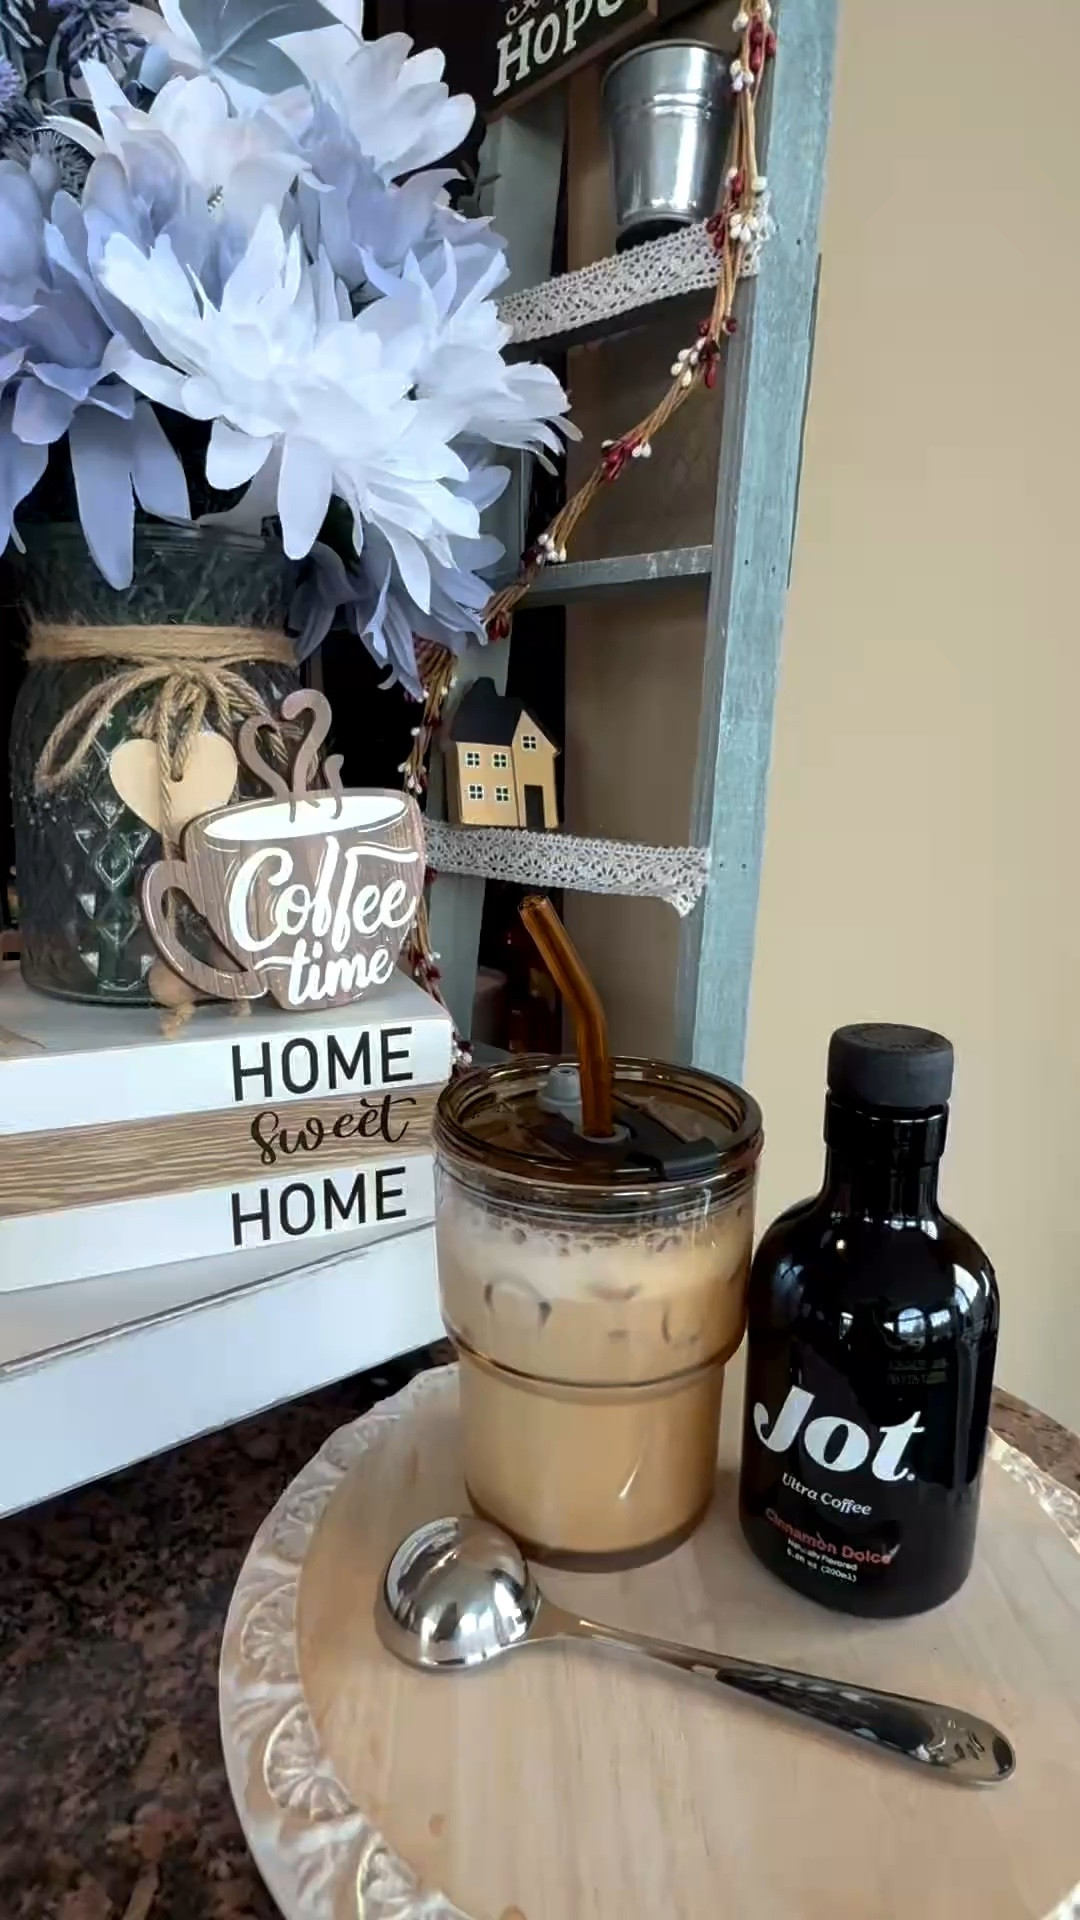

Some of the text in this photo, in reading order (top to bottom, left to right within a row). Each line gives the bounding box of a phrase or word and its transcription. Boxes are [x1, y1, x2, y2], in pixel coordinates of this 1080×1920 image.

[229, 835, 419, 952] Coffee
[254, 938, 394, 1006] time
[231, 1026, 413, 1101] HOME
[231, 1166, 407, 1246] HOME
[782, 1472, 872, 1515] Ultra Coffee
[765, 1507, 892, 1565] Cinnamon Dolce
